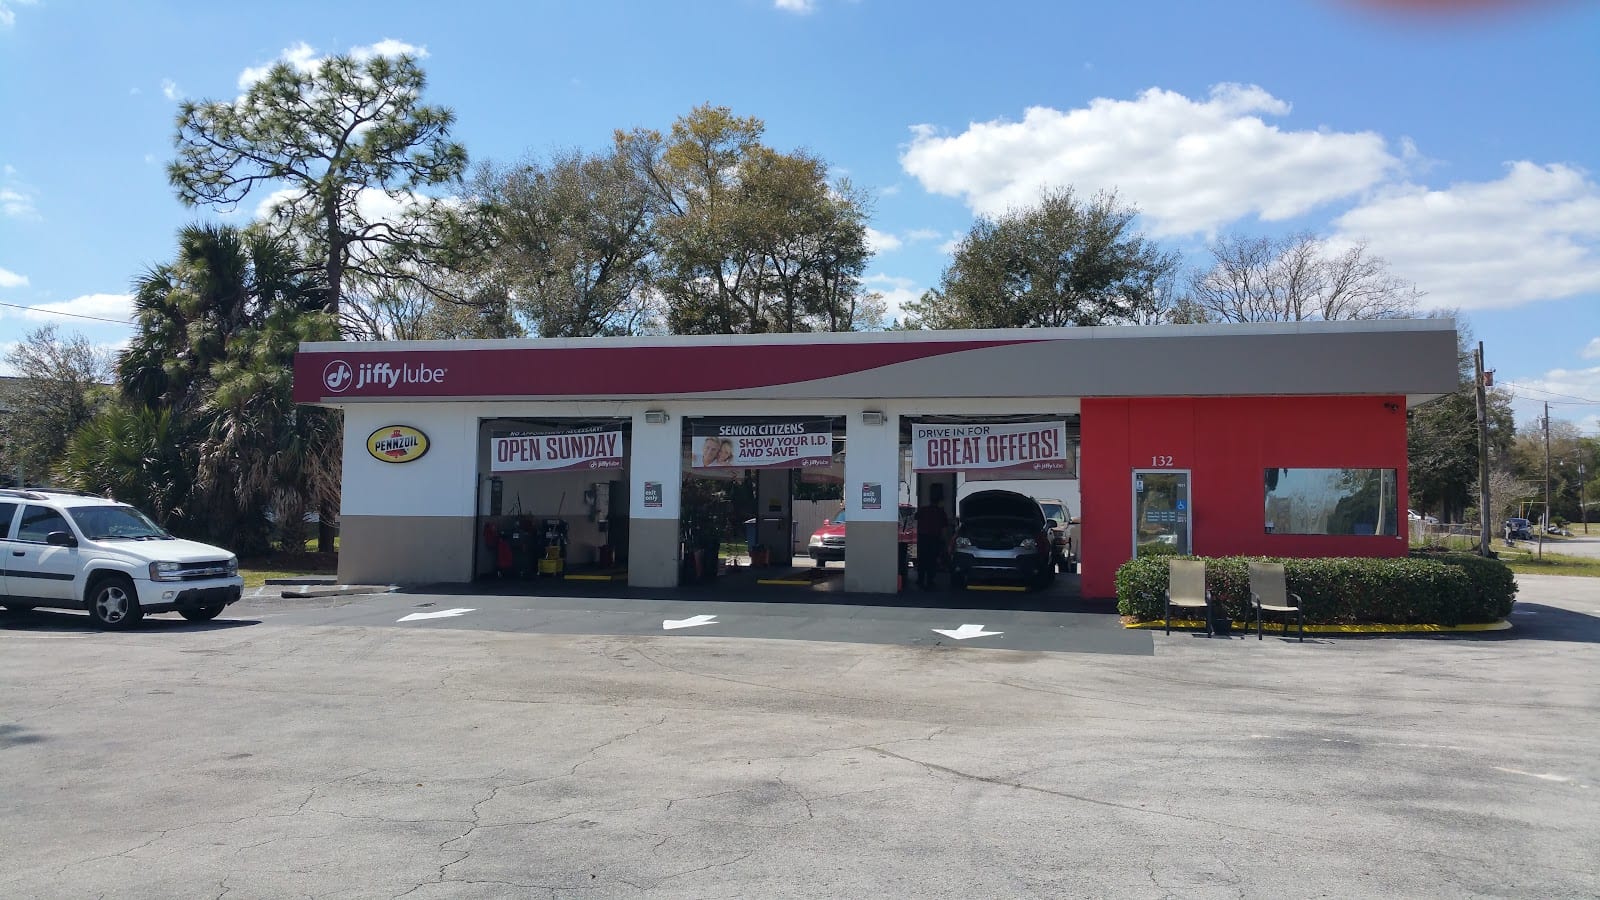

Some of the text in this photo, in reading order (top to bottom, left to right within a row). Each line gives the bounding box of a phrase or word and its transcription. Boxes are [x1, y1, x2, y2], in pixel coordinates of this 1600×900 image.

[356, 362, 445, 389] jiffy lube
[719, 423, 805, 436] SENIOR CITIZENS
[918, 426, 990, 438] DRIVE IN FOR
[375, 435, 419, 452] PENNZOIL
[498, 433, 617, 463] OPEN SUNDAY
[739, 435, 828, 448] SHOW YOUR I.D.
[927, 428, 1059, 467] GREAT OFFERS!
[738, 446, 799, 458] AND SAVE!
[1151, 455, 1173, 467] 132
[863, 496, 876, 504] only
